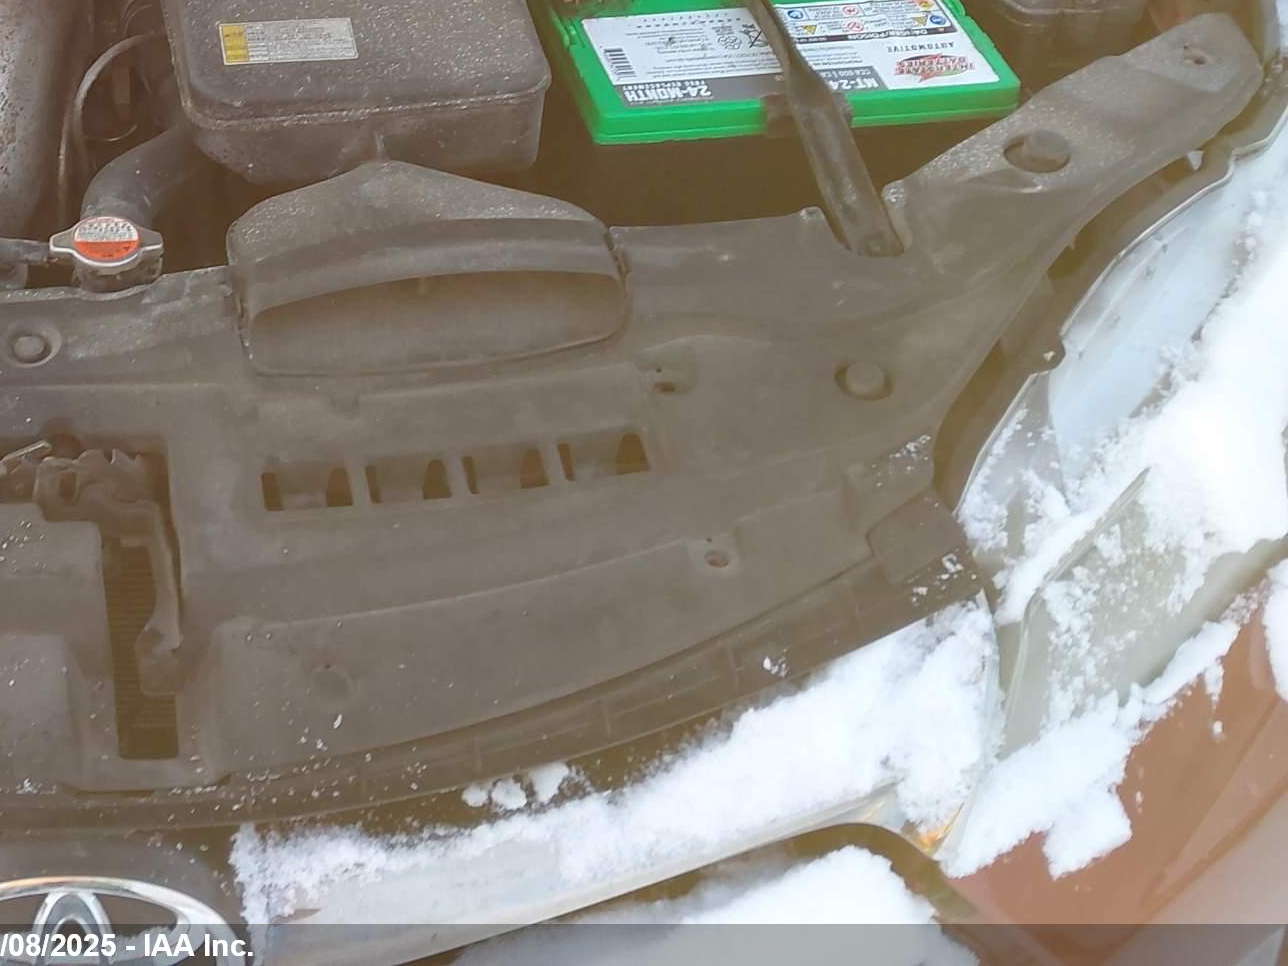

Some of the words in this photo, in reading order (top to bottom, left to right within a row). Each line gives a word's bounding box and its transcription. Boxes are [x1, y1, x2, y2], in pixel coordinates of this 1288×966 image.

[887, 41, 955, 53] AUTOMOTIVE
[896, 55, 967, 68] BATTERIES
[894, 62, 976, 76] INTERSTATE
[623, 84, 712, 103] 24-MONTH
